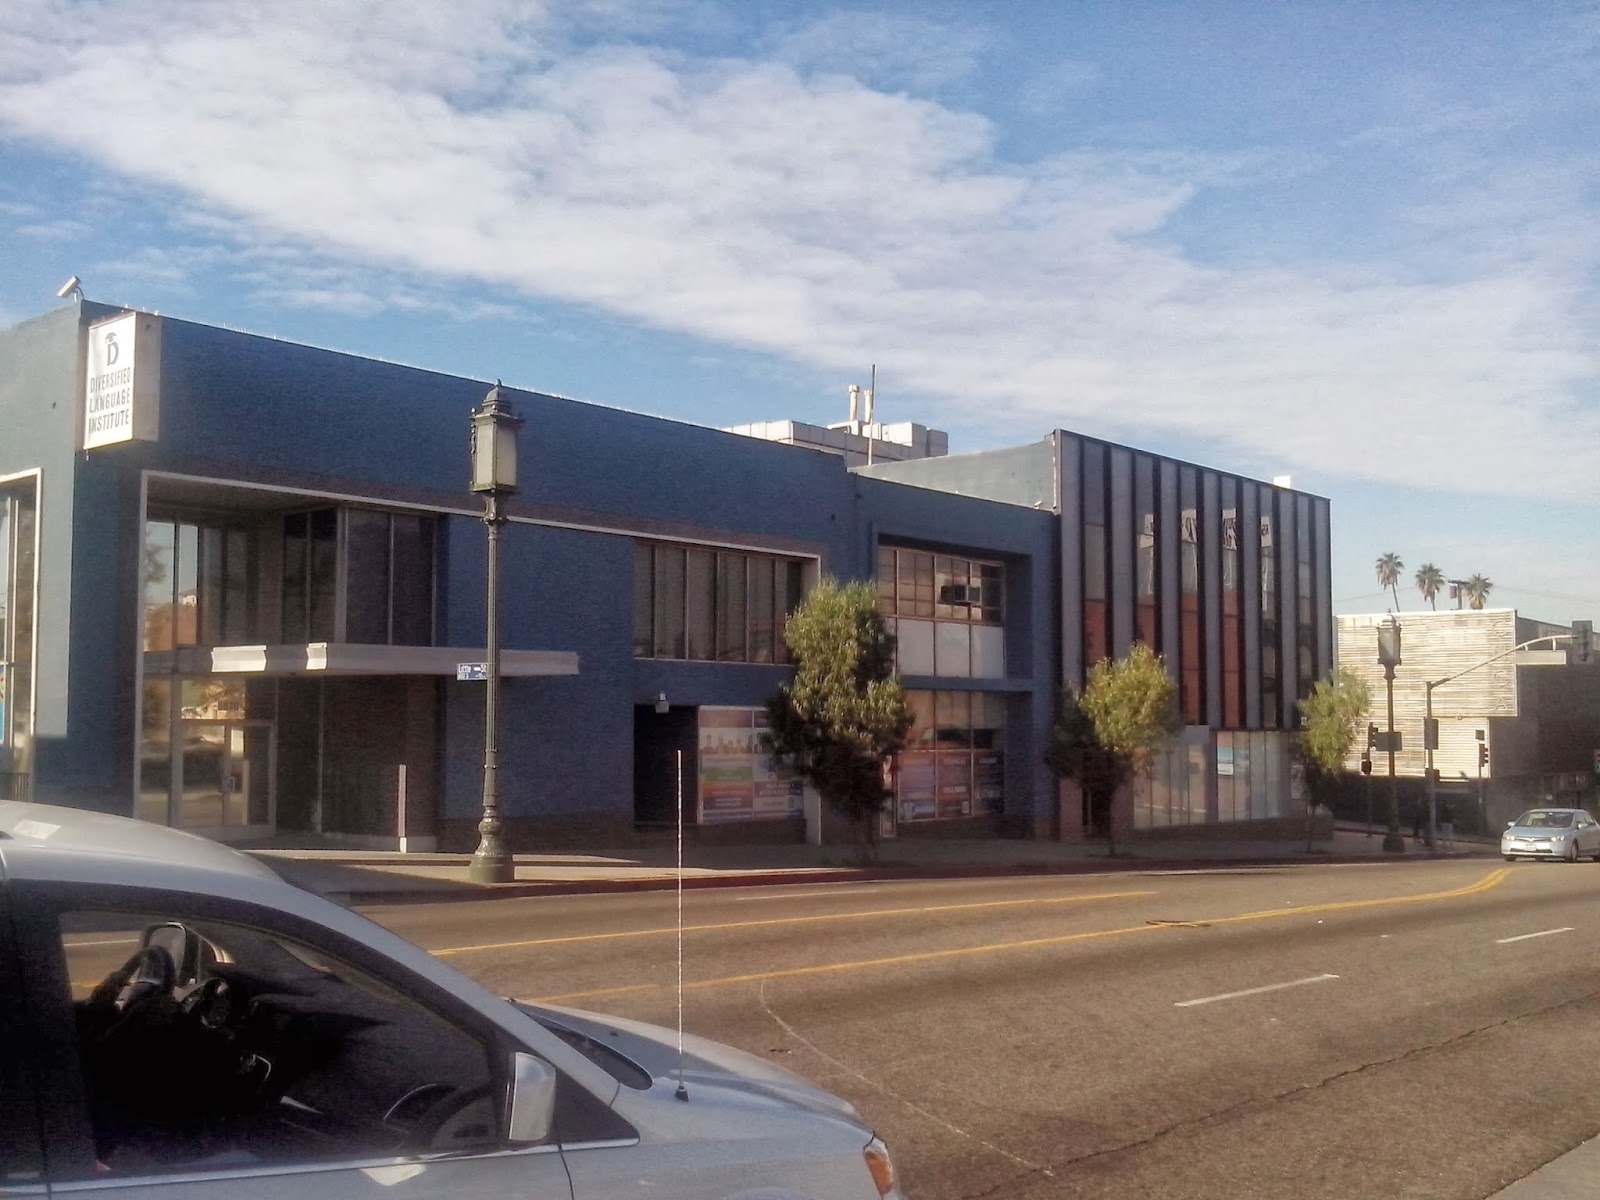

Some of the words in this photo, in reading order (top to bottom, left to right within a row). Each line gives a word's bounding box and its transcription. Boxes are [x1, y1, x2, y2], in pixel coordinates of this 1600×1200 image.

[106, 341, 119, 367] D
[90, 366, 131, 394] DIVERSIFIED
[89, 387, 131, 413] LANGUAGE
[88, 408, 129, 434] INSTITUTE
